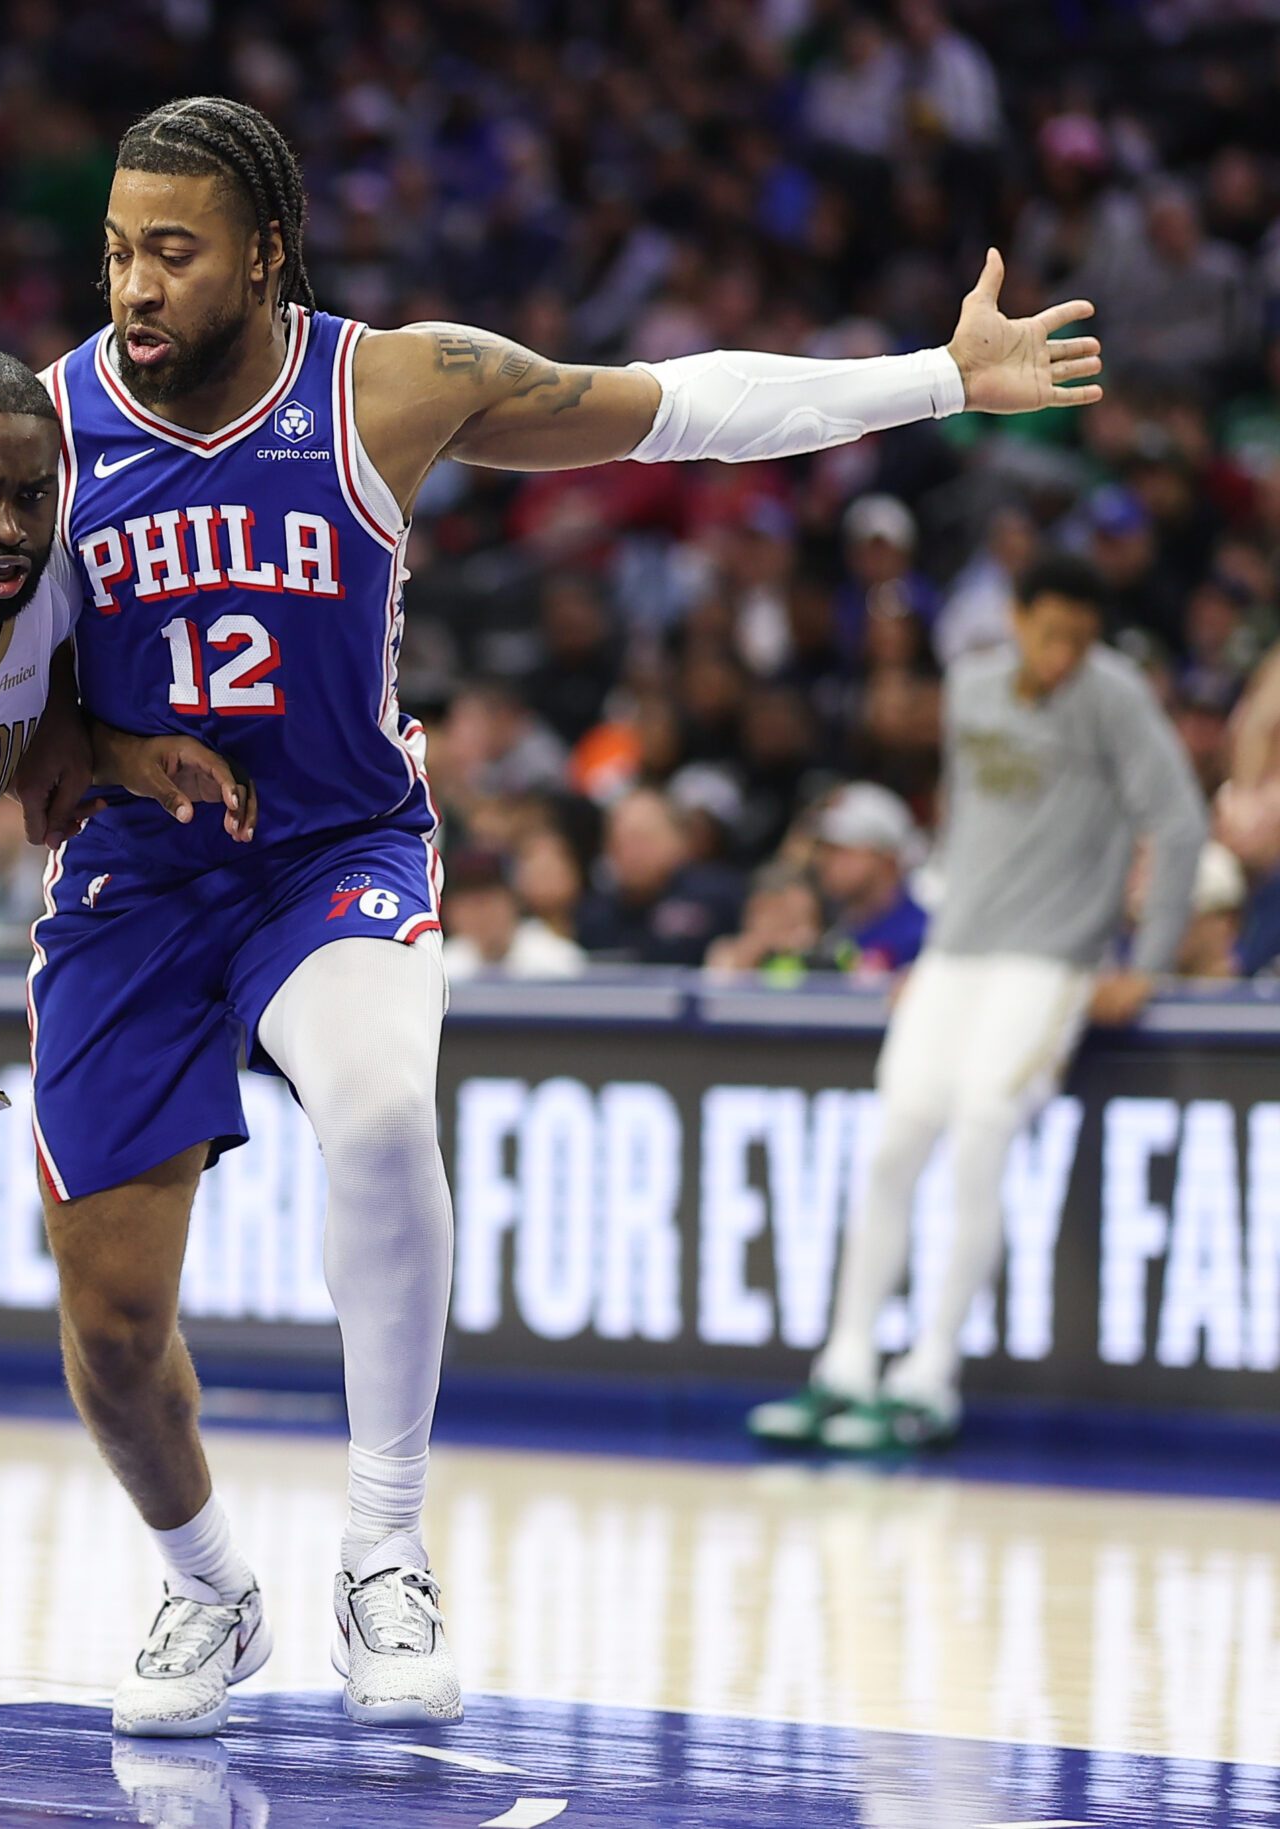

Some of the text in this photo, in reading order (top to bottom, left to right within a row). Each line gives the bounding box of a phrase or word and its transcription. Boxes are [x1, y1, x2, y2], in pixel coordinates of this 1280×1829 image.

[256, 448, 330, 461] crypto.com
[78, 505, 345, 613] PHILA
[161, 615, 285, 715] 12
[325, 886, 401, 921] 76
[452, 1076, 683, 1341] FOR
